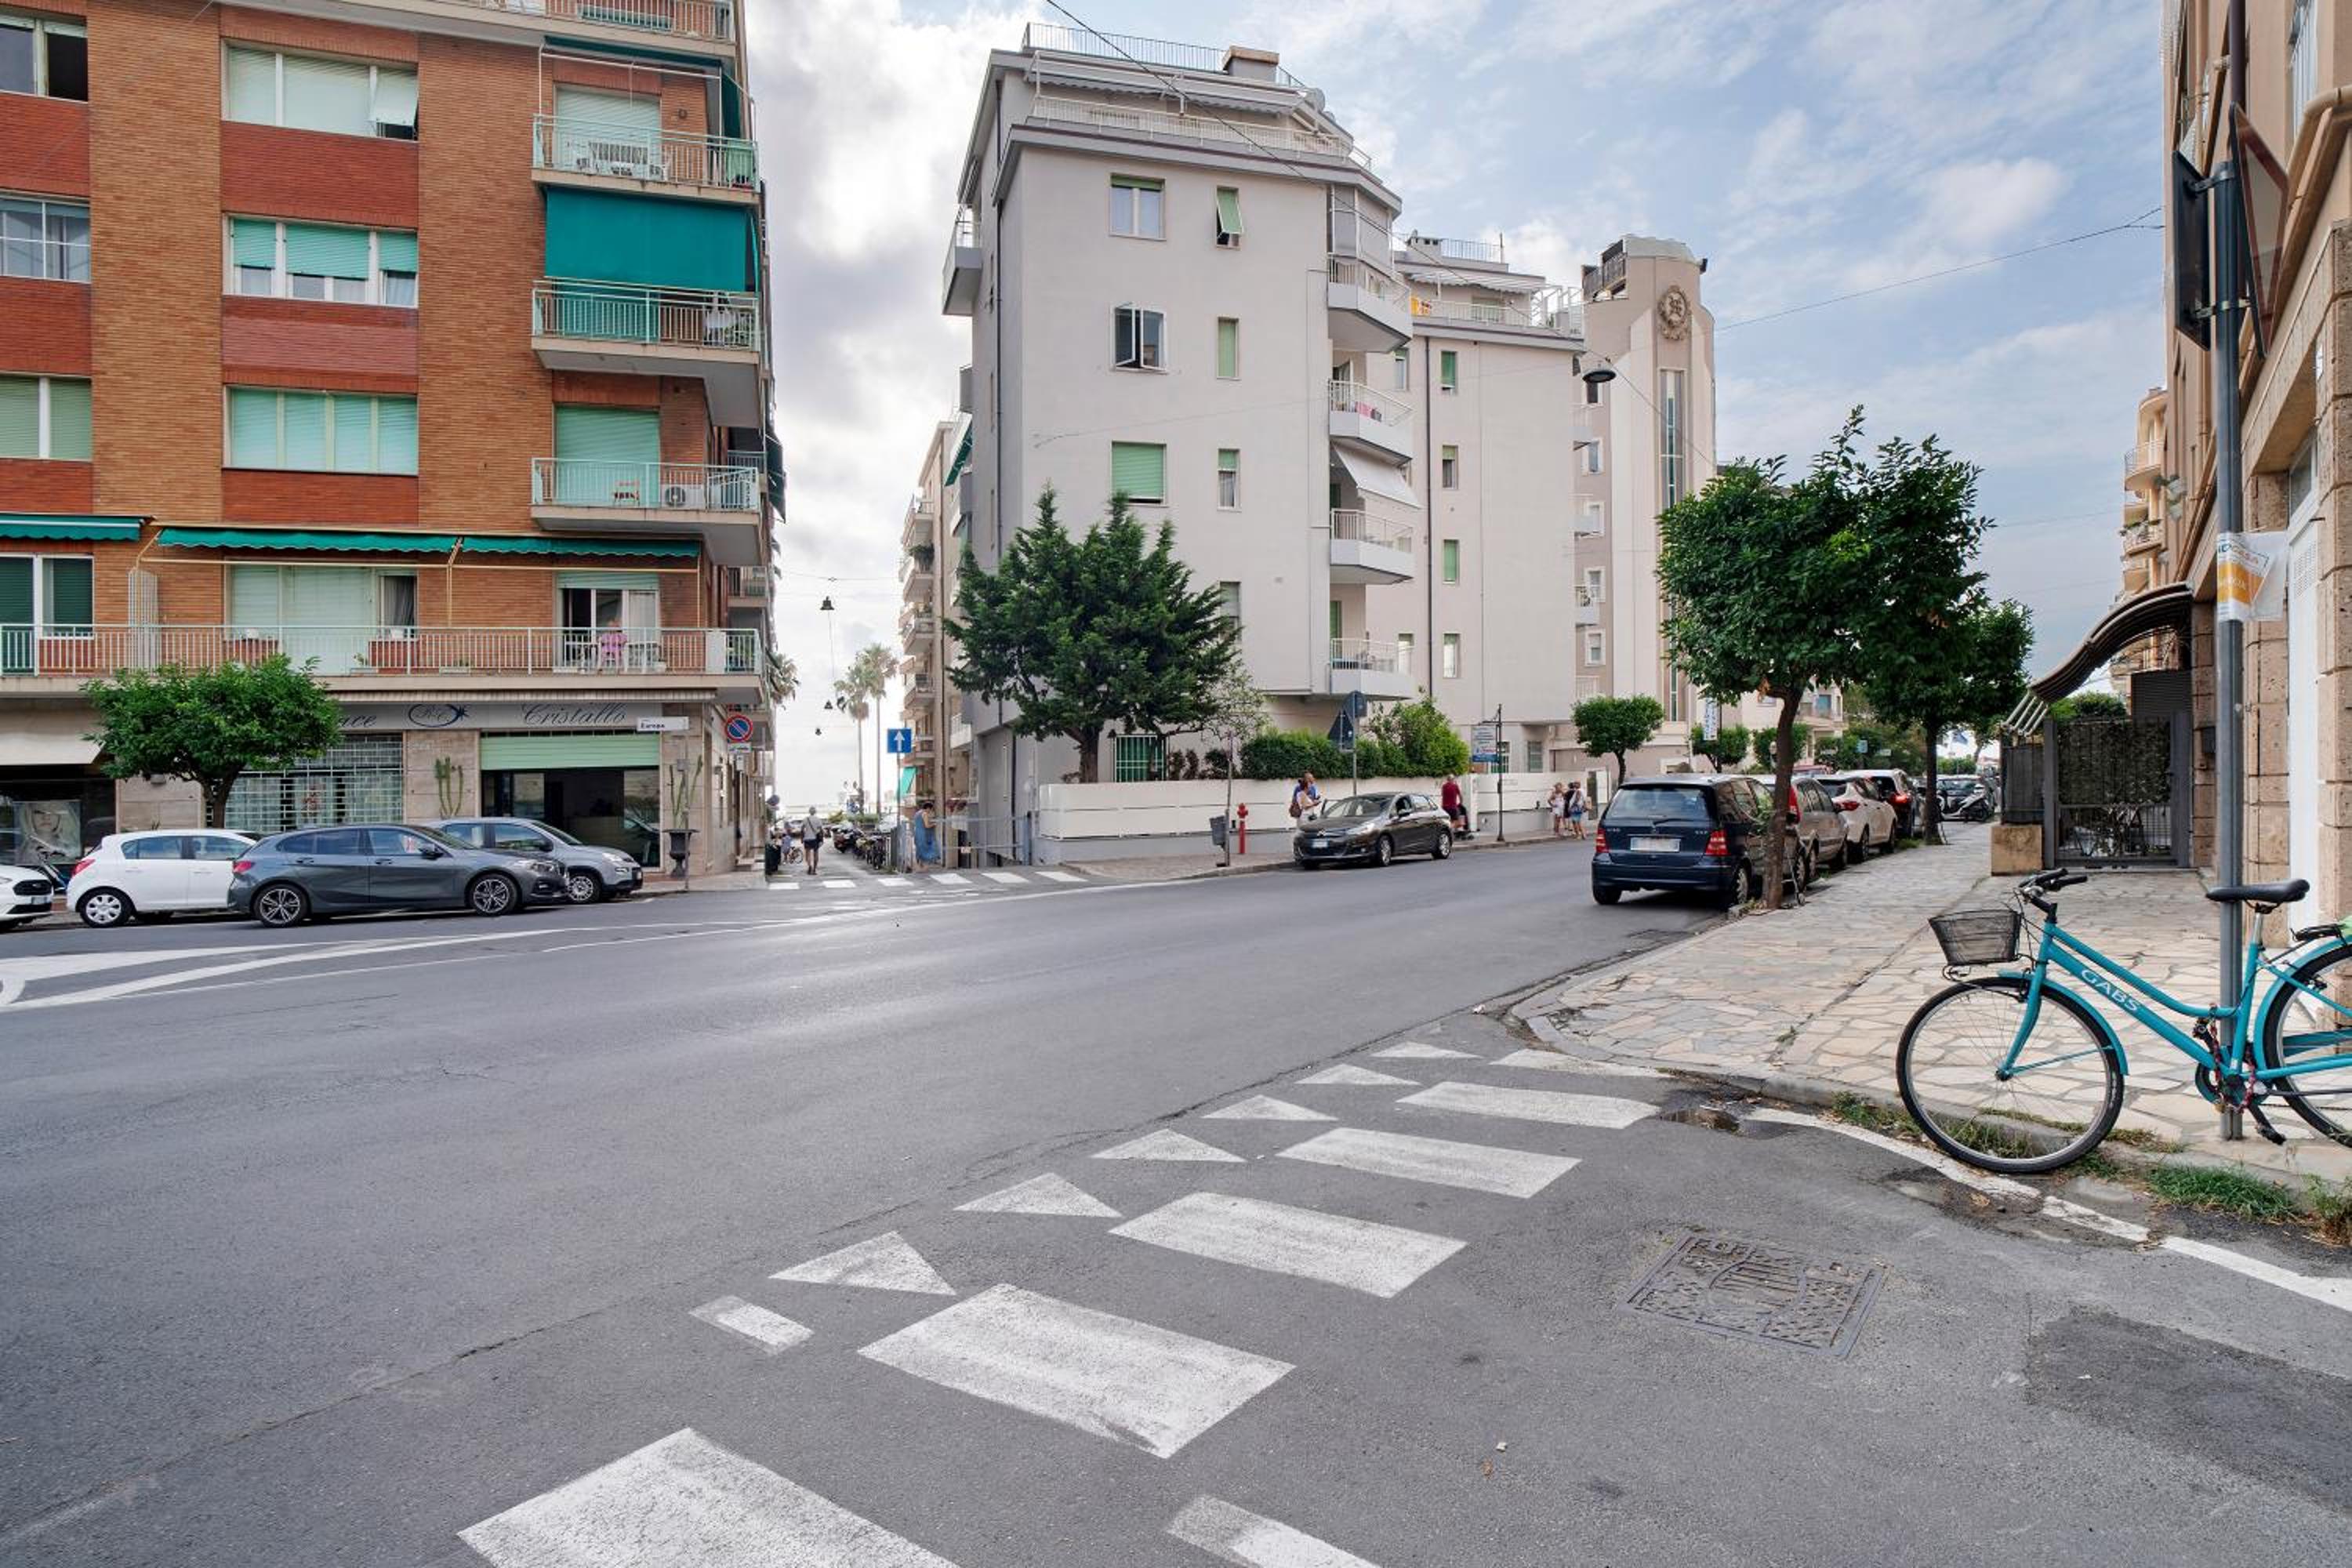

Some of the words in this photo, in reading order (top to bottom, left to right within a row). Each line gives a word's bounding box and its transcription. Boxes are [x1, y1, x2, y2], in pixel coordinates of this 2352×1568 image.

[521, 702, 626, 725] Cristallo
[641, 721, 666, 730] Europa
[2082, 970, 2140, 1011] GABS
